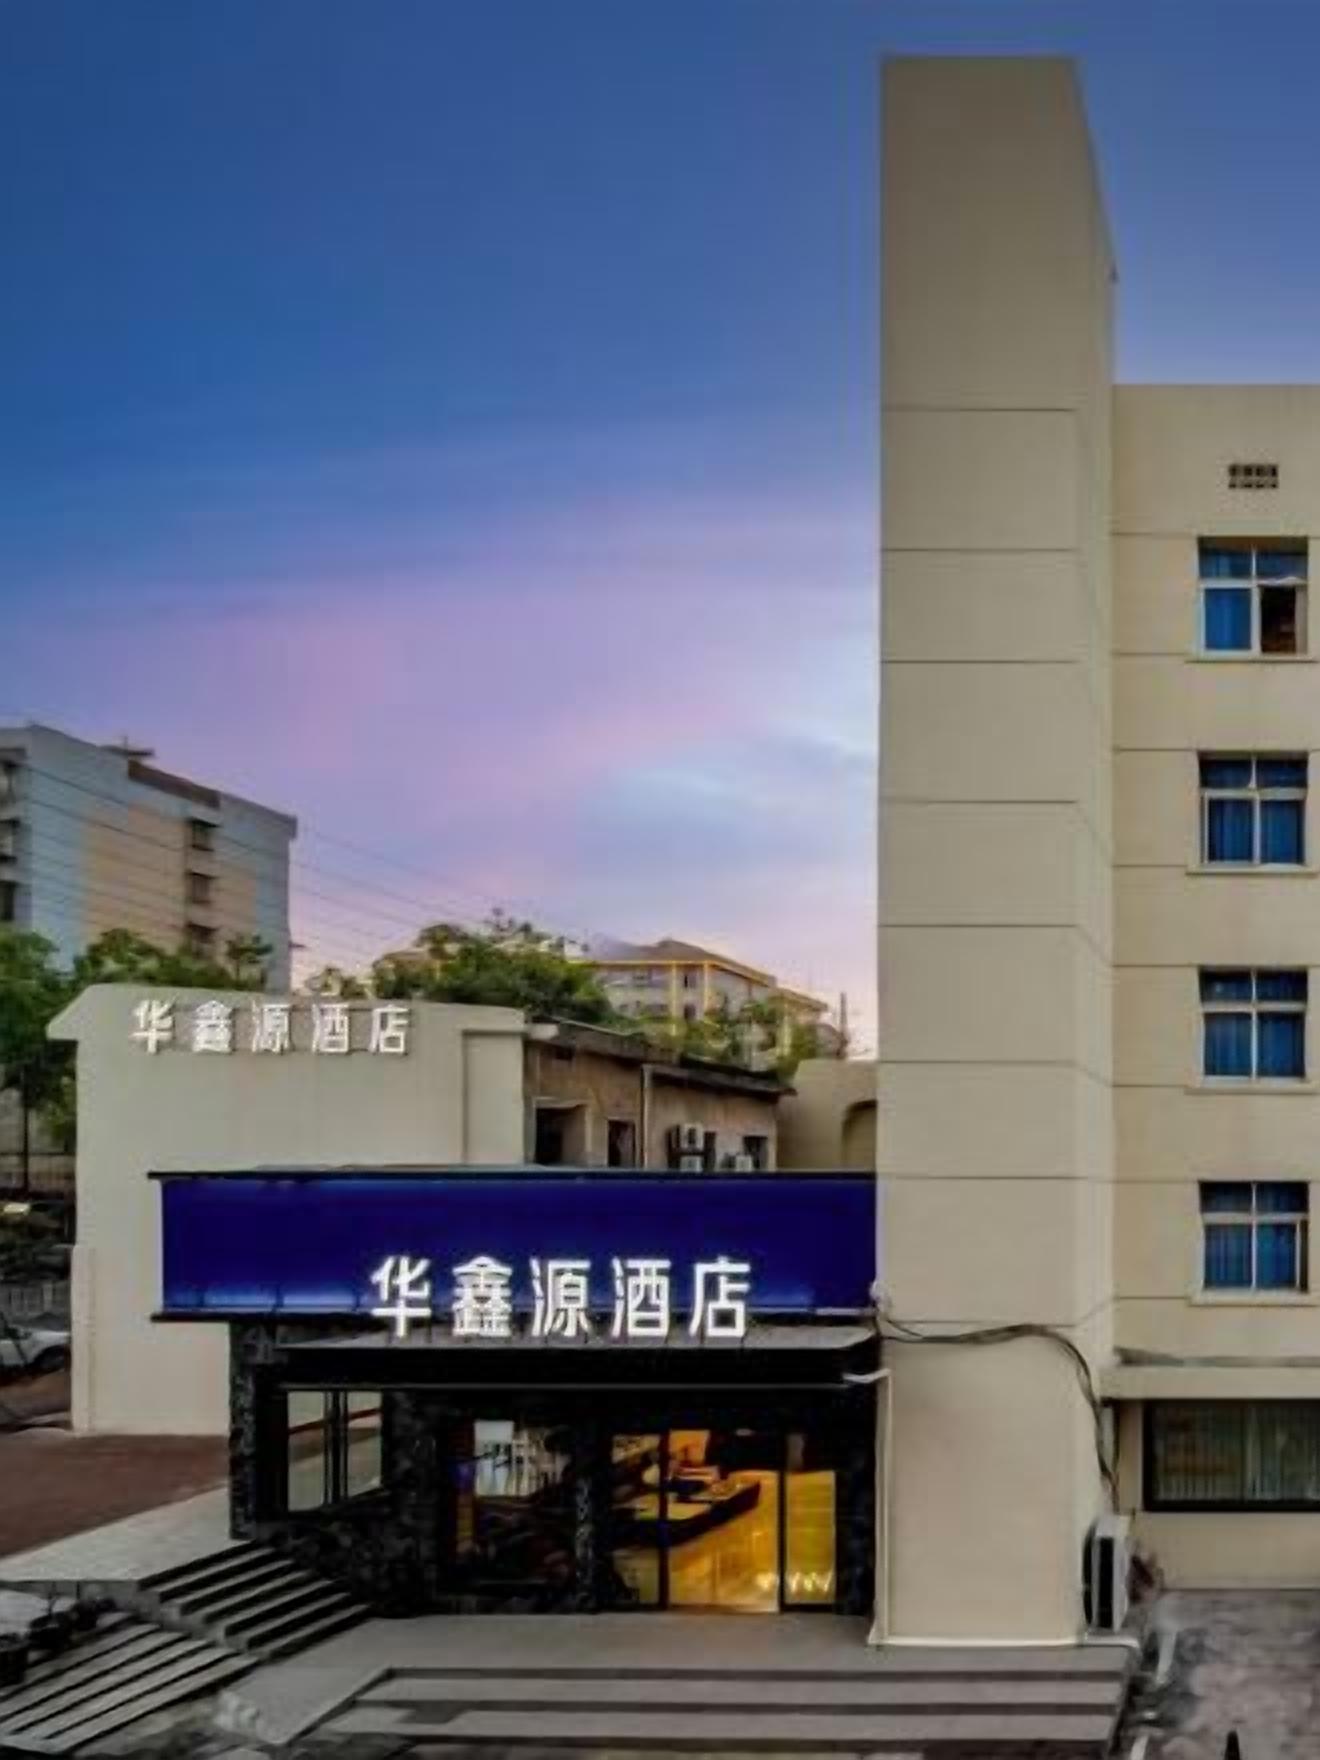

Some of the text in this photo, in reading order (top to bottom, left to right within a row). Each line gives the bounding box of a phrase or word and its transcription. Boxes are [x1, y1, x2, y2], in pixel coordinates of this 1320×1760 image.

[130, 999, 409, 1054] 华鑫源酒店
[371, 1255, 751, 1338] 华鑫源酒店
